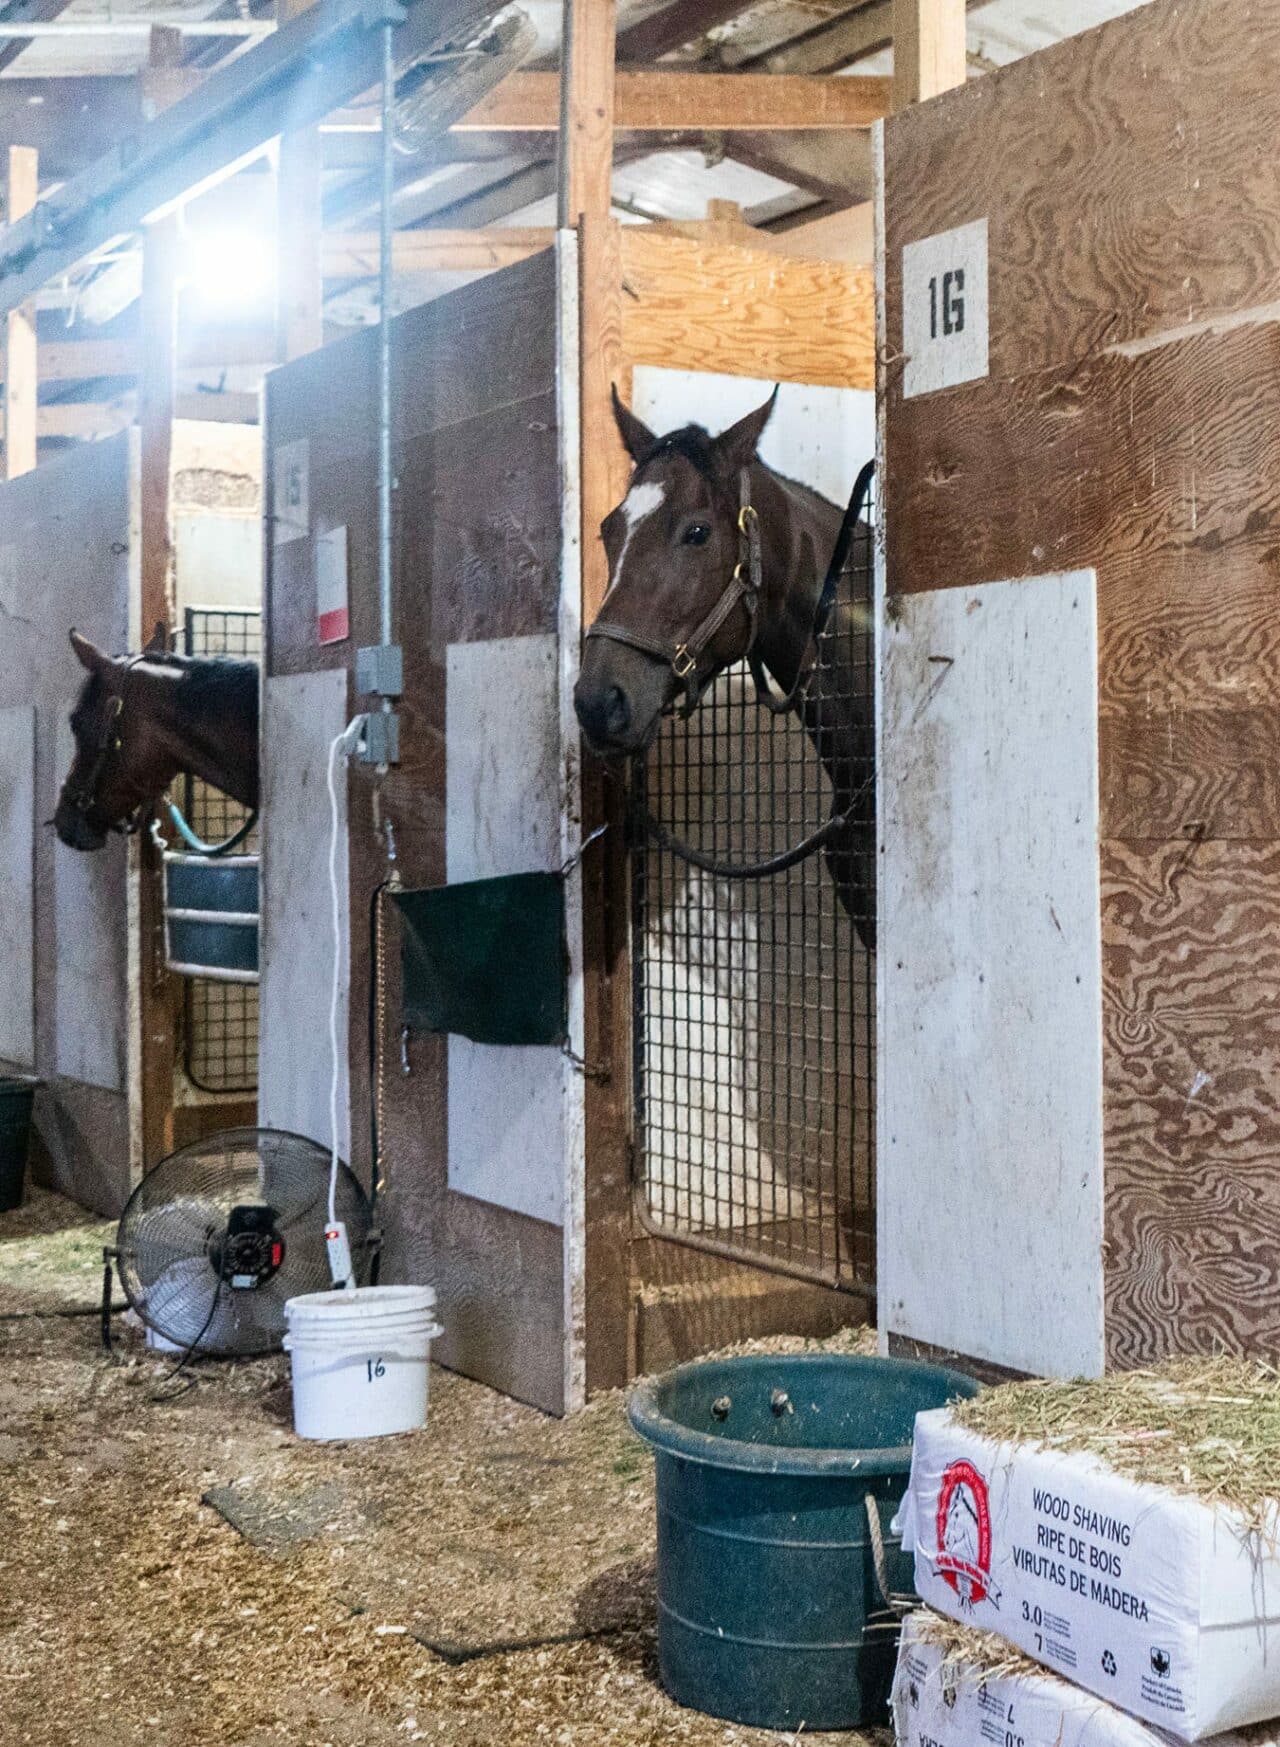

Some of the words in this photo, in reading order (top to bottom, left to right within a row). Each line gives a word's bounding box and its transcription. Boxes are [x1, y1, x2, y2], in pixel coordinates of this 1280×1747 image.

[367, 1357, 386, 1383] 16
[1033, 1488, 1070, 1521] WOOD
[1073, 1504, 1130, 1546] SHAVING
[1037, 1524, 1065, 1554] RIPE
[1069, 1537, 1086, 1563] DE
[1090, 1545, 1122, 1577] BOIS
[1012, 1545, 1066, 1586] VIRUTAS
[1070, 1570, 1088, 1597] DE
[1091, 1579, 1149, 1622] MADERA
[1022, 1600, 1042, 1626] 3.0
[1034, 1632, 1042, 1653] 7
